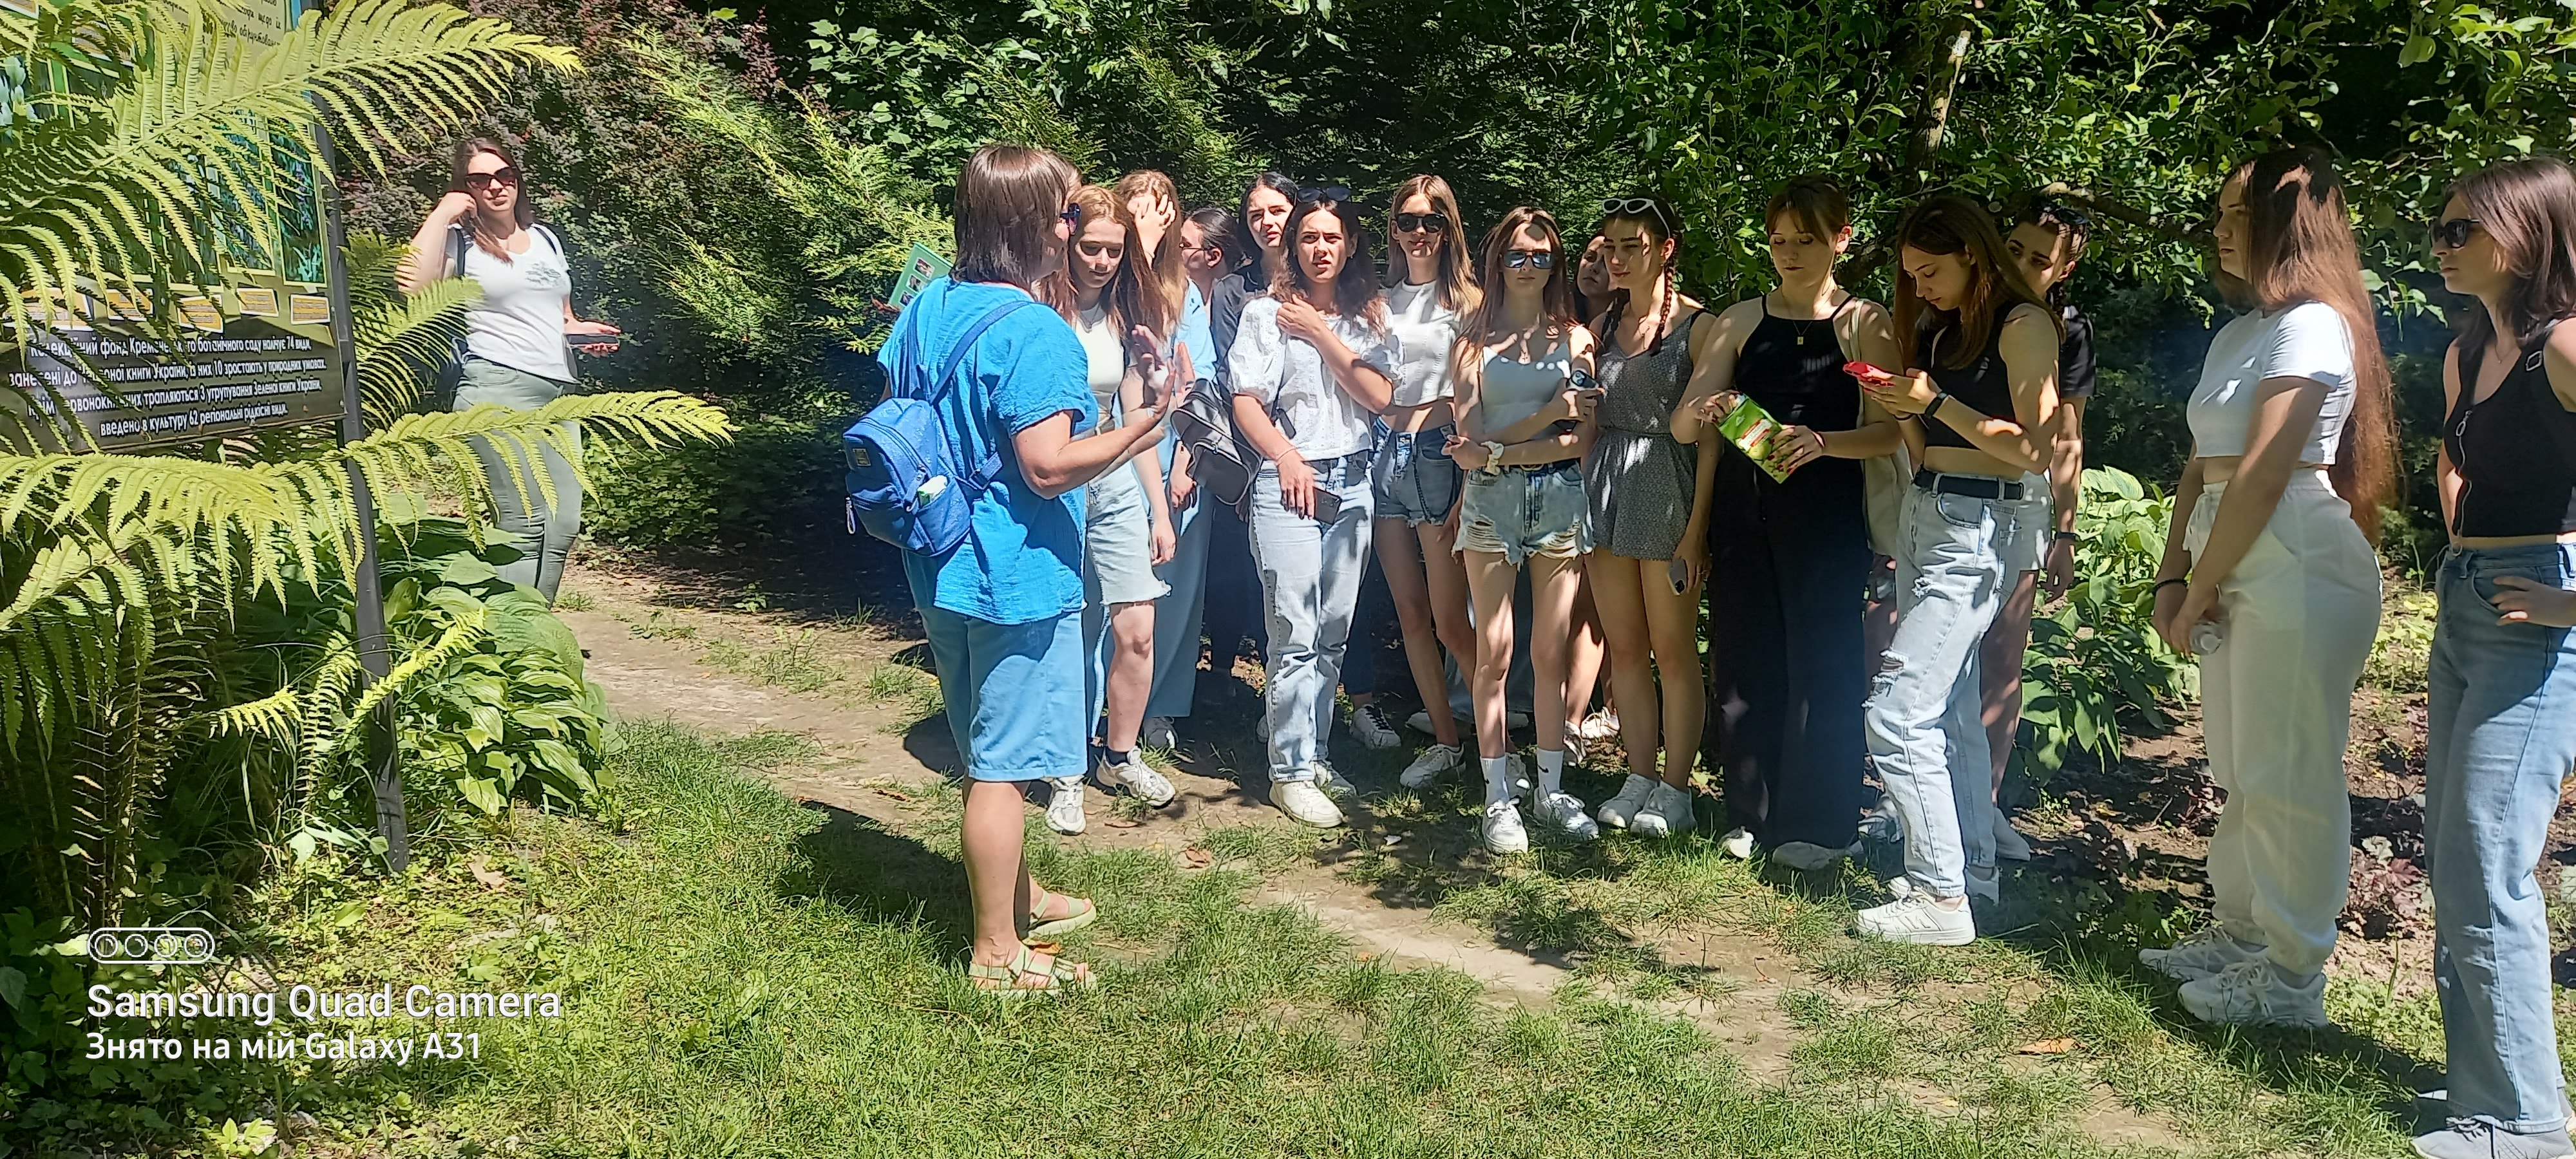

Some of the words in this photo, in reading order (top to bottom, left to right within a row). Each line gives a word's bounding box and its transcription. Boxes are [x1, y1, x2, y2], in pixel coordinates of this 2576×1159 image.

[197, 335, 244, 352] ботанічного
[245, 339, 261, 353] саду
[262, 336, 286, 353] налічує
[287, 335, 294, 350] 74
[63, 370, 77, 386] до
[126, 368, 151, 381] книги
[153, 361, 189, 384] України,
[198, 364, 213, 379] них
[214, 359, 223, 375] 10
[224, 361, 262, 379] зростають
[268, 359, 302, 377] природних
[144, 389, 198, 409] трапляються
[200, 385, 205, 401] 3
[207, 384, 252, 404] угрупування
[253, 379, 278, 396] Зеленої
[279, 381, 296, 393] книги
[100, 420, 140, 437] введено
[149, 414, 188, 434] культуру
[189, 409, 199, 426] 62
[200, 405, 243, 426] регіональні
[244, 402, 270, 422] рідкісні
